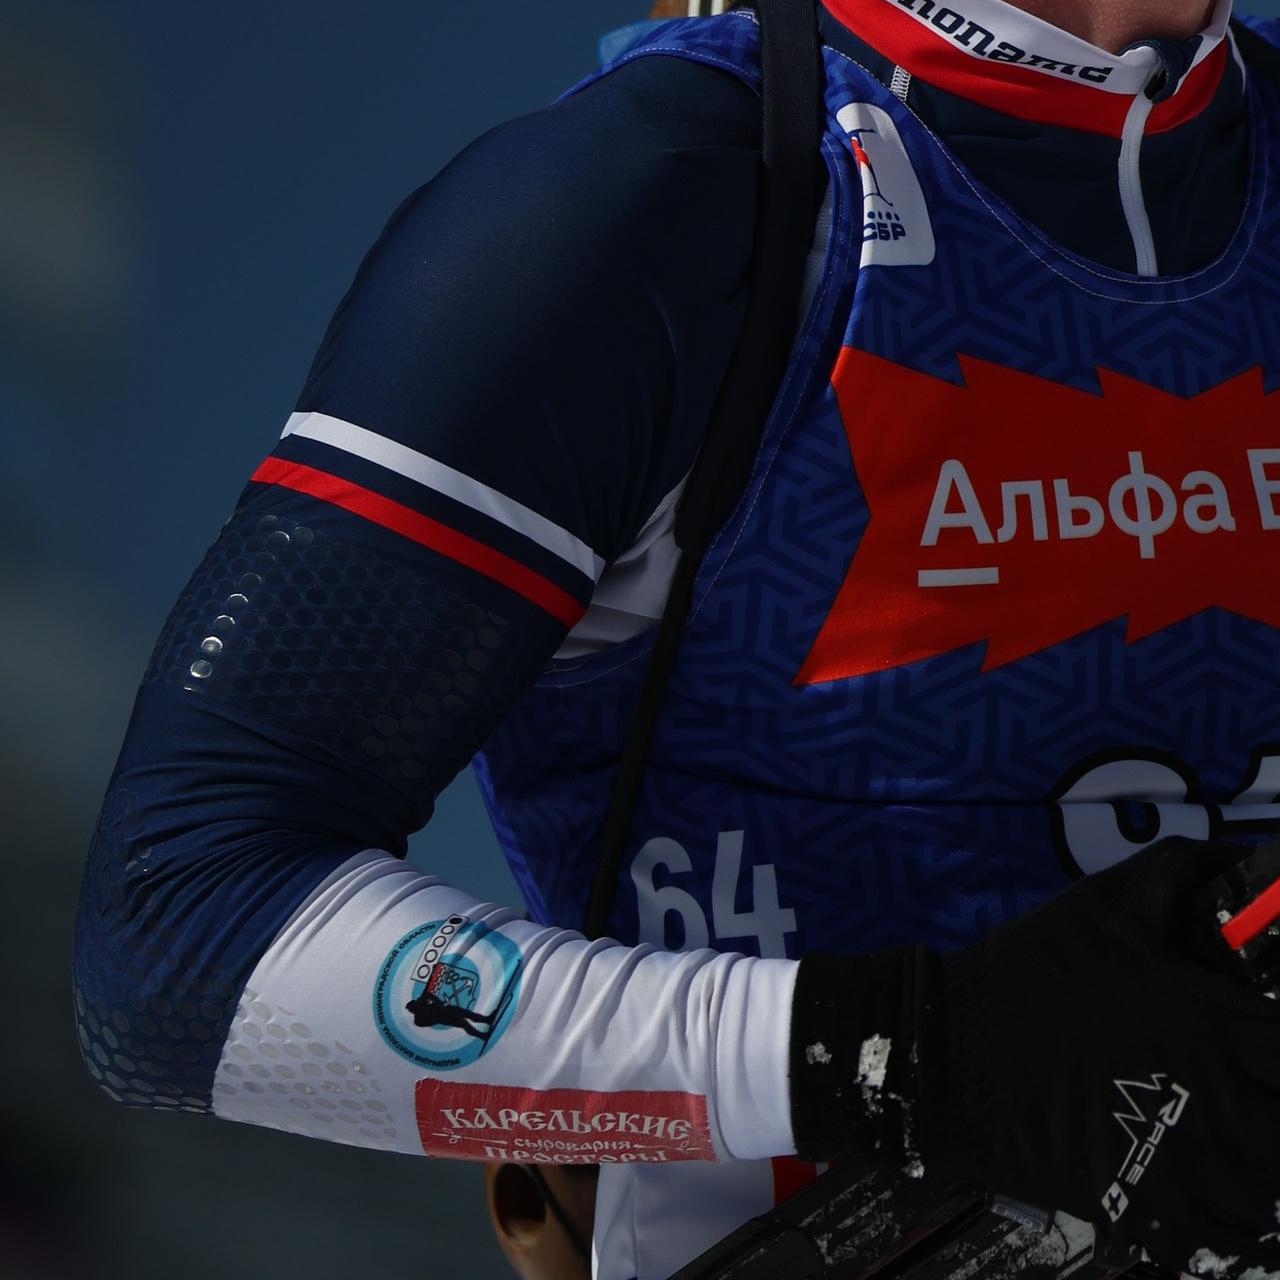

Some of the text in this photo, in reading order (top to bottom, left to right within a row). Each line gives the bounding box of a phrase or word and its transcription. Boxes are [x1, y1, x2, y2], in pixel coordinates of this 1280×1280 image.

[862, 220, 906, 241] СБР
[917, 450, 1236, 562] Альфа
[630, 829, 798, 960] 64
[382, 1026, 414, 1058] БИАТЛОНА
[398, 923, 435, 949] ОБЛАСТИ
[440, 1107, 691, 1141] КАРЕЛЬСКИЕ
[1124, 1081, 1191, 1186] RACE
